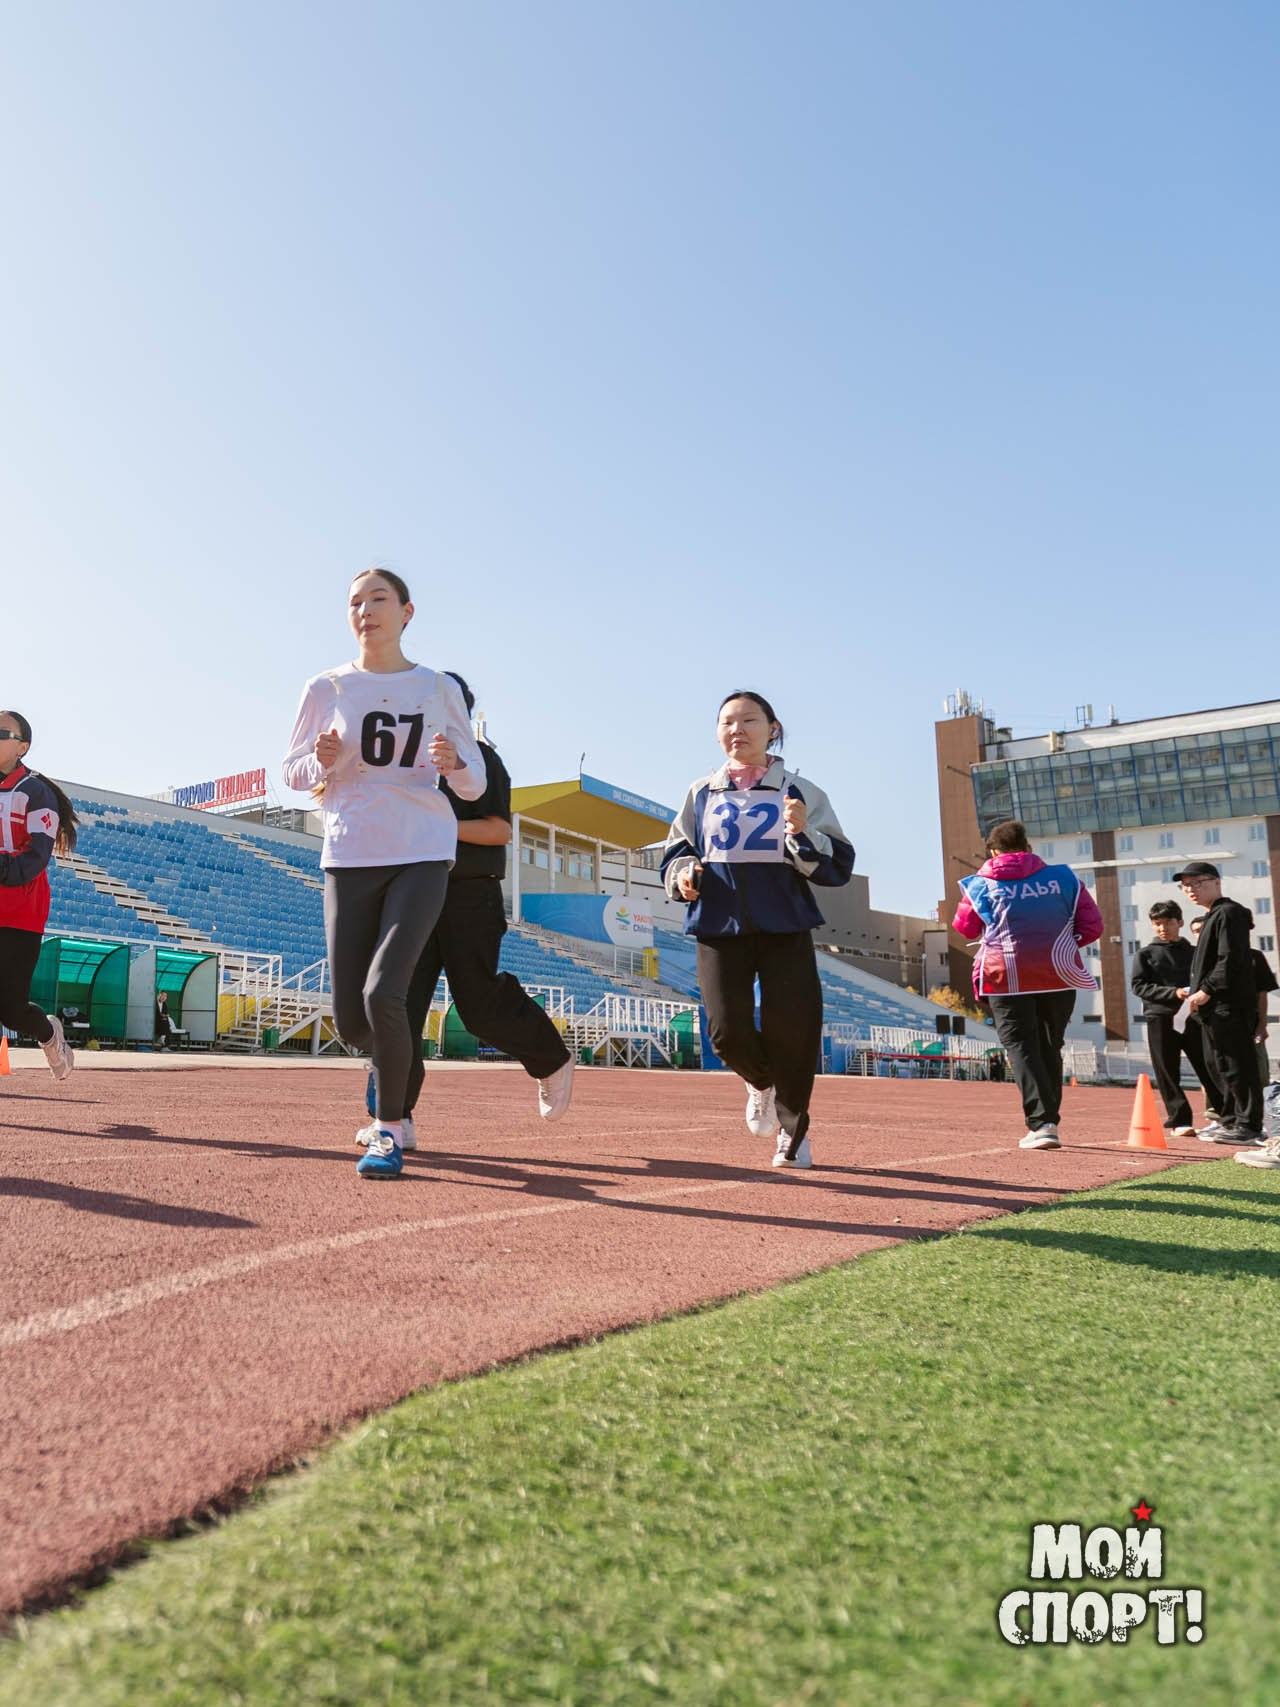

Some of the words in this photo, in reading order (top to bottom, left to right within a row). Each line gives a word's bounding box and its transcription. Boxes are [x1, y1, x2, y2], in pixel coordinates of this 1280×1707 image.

[361, 711, 424, 768] 67
[214, 768, 266, 800] TRIUMPH
[711, 802, 779, 850] 32
